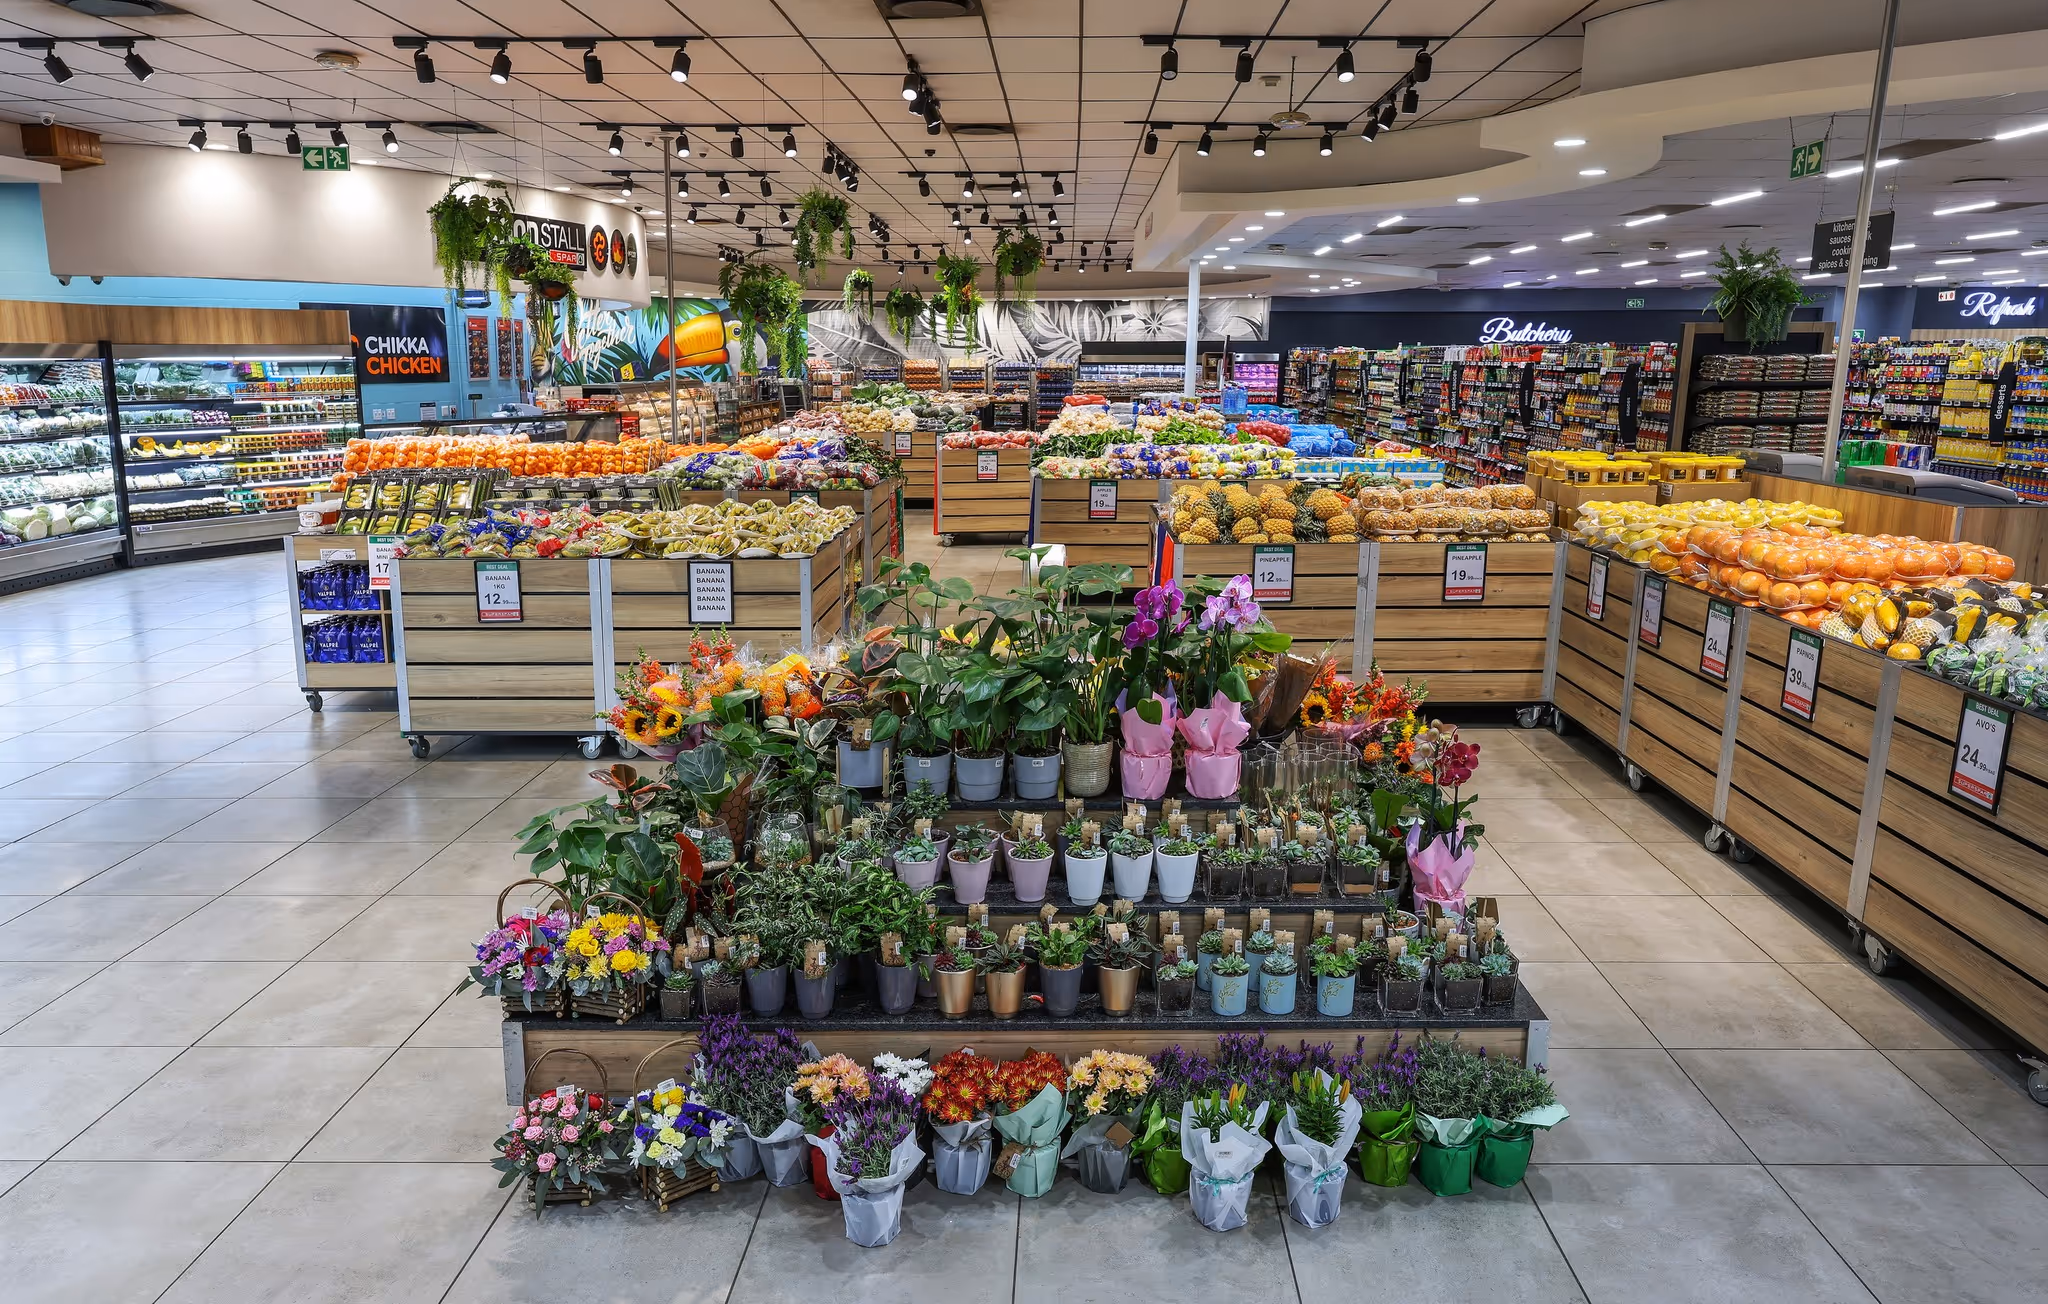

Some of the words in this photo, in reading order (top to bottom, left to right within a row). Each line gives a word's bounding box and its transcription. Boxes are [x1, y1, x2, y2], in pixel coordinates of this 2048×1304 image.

[541, 224, 584, 250] STALL
[1829, 235, 1852, 244] sauces
[556, 253, 576, 262] SPAR
[1818, 260, 1838, 270] spices
[1960, 292, 2036, 325] Refresh
[1479, 317, 1572, 343] Butchery
[365, 336, 429, 354] CHIKKA
[366, 356, 440, 374] CHICKEN
[1994, 384, 2006, 420] desserts
[1797, 648, 1815, 661] PAPINOS
[1976, 702, 1986, 712] BEST
[1988, 705, 2000, 718] DEAL
[1976, 719, 1996, 733] AVO'S
